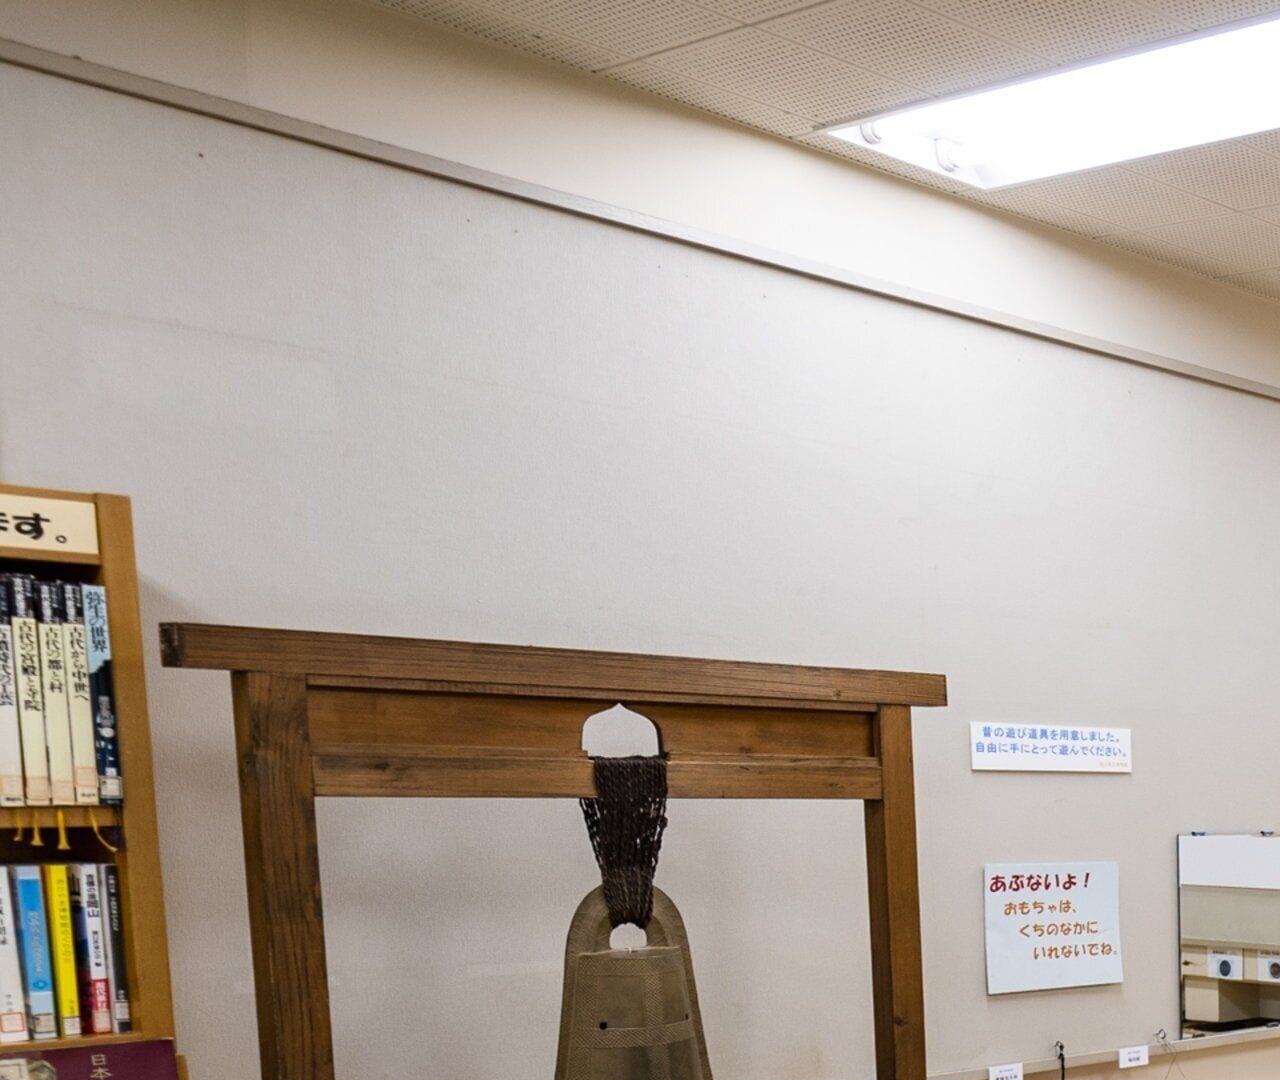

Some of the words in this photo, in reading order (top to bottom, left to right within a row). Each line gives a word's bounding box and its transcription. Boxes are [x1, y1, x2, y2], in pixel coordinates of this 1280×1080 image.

[989, 872, 1090, 892] あぶないよ！
[1004, 900, 1076, 916] おもちゃは、
[1020, 921, 1098, 938] くちのなかに
[1033, 942, 1118, 960] いれないでね。
